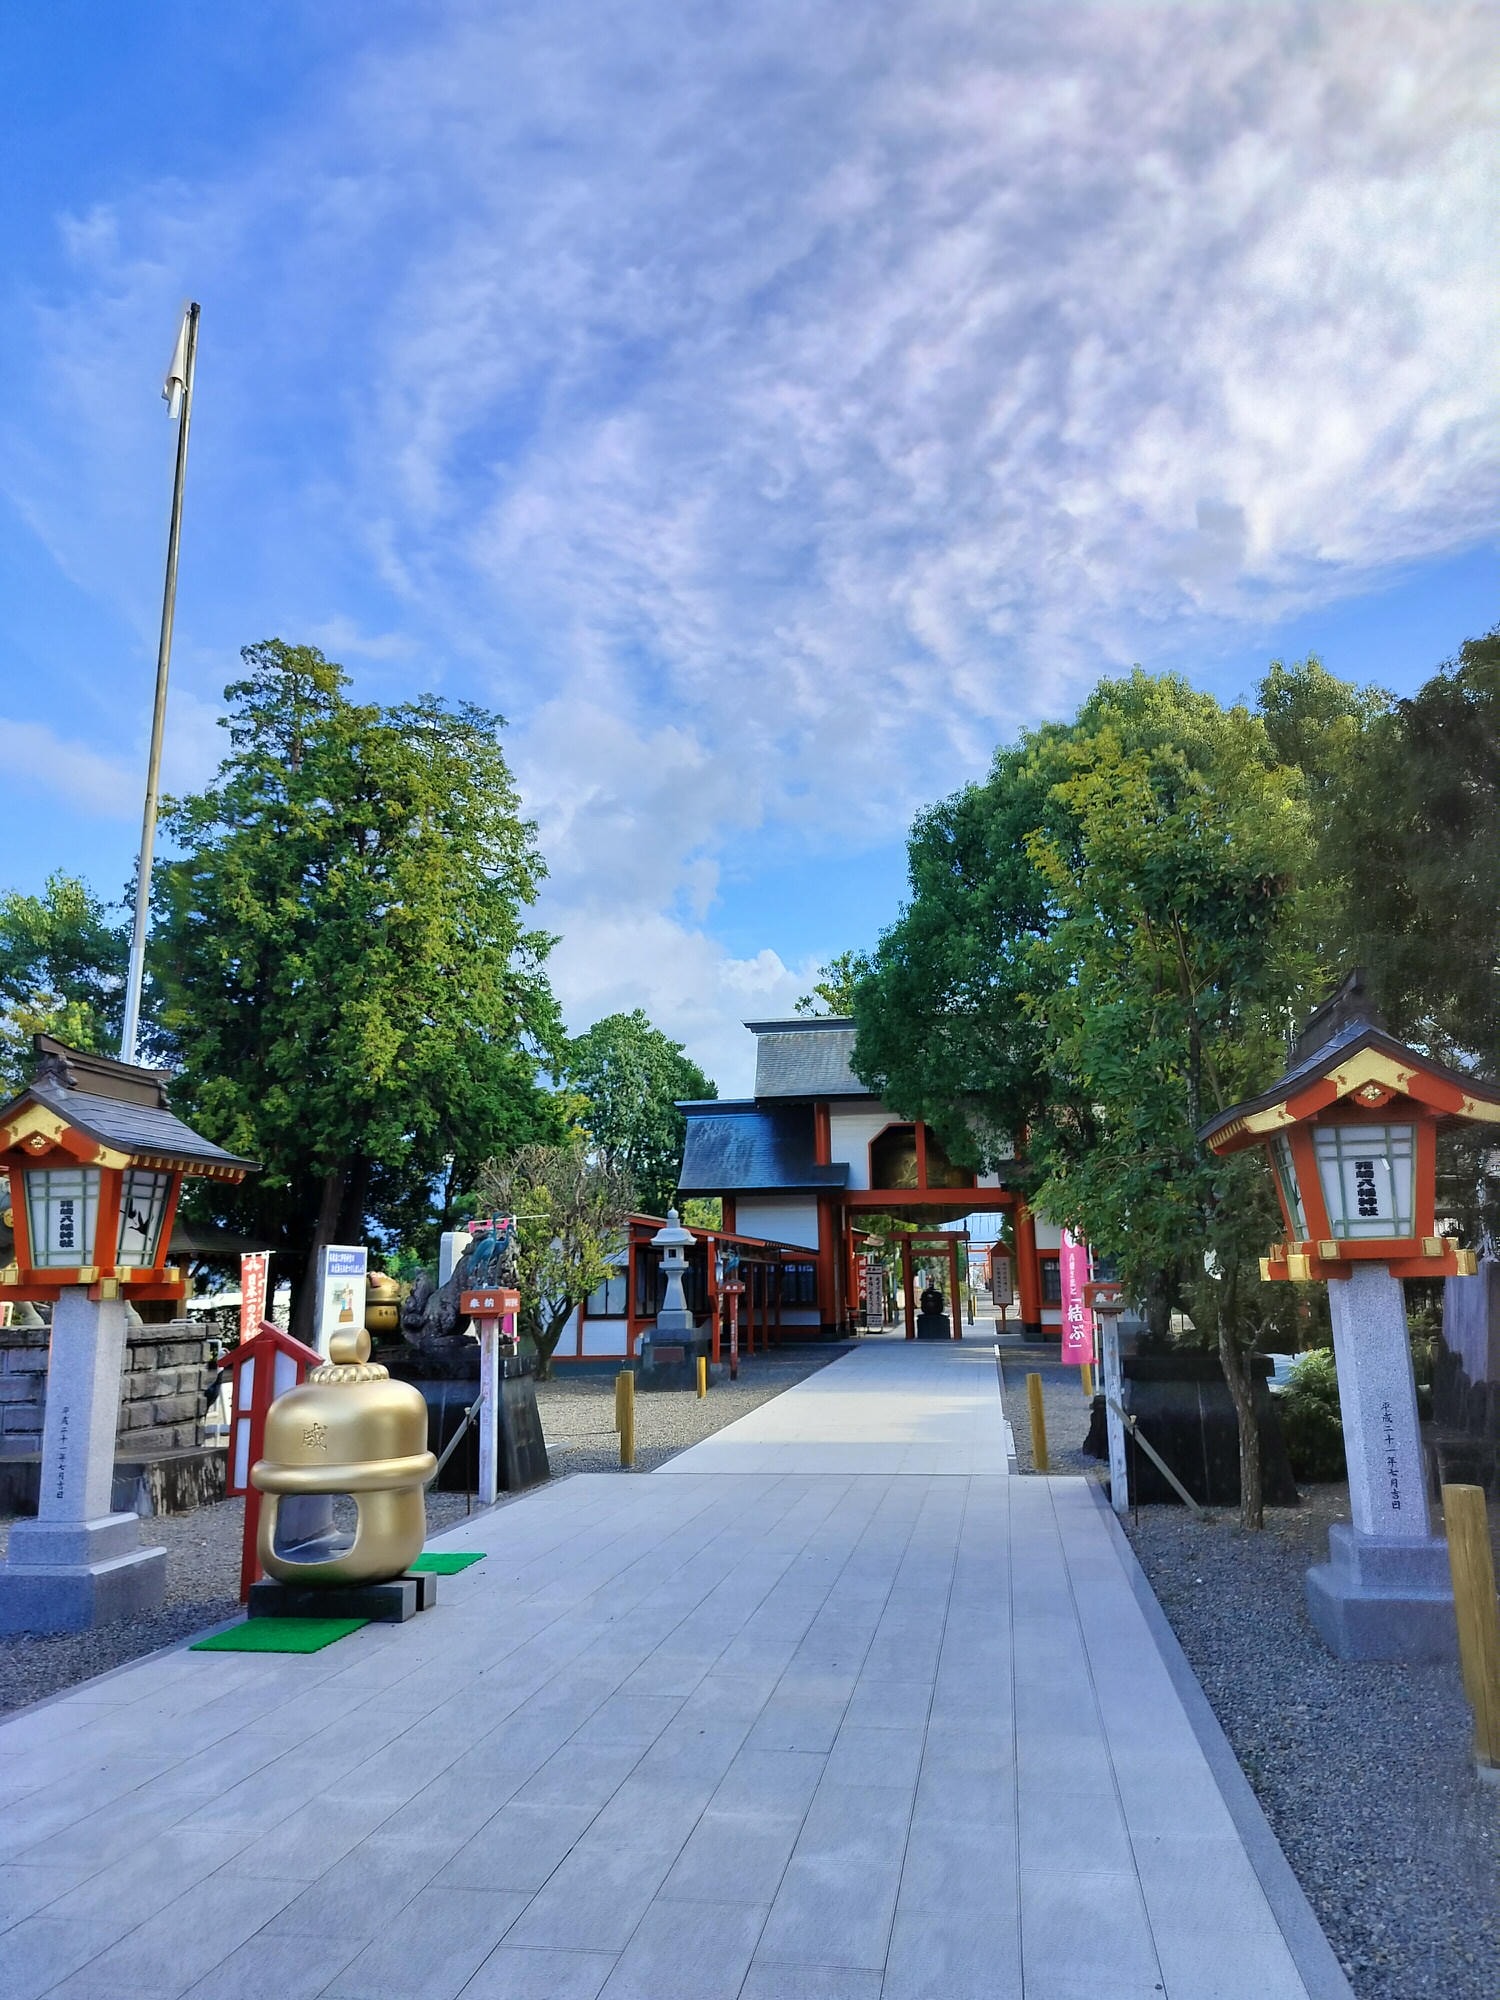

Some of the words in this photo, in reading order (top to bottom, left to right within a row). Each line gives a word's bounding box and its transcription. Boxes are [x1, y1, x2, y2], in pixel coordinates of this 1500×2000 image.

[1381, 1402, 1401, 1510] 平成二十一年七月吉日
